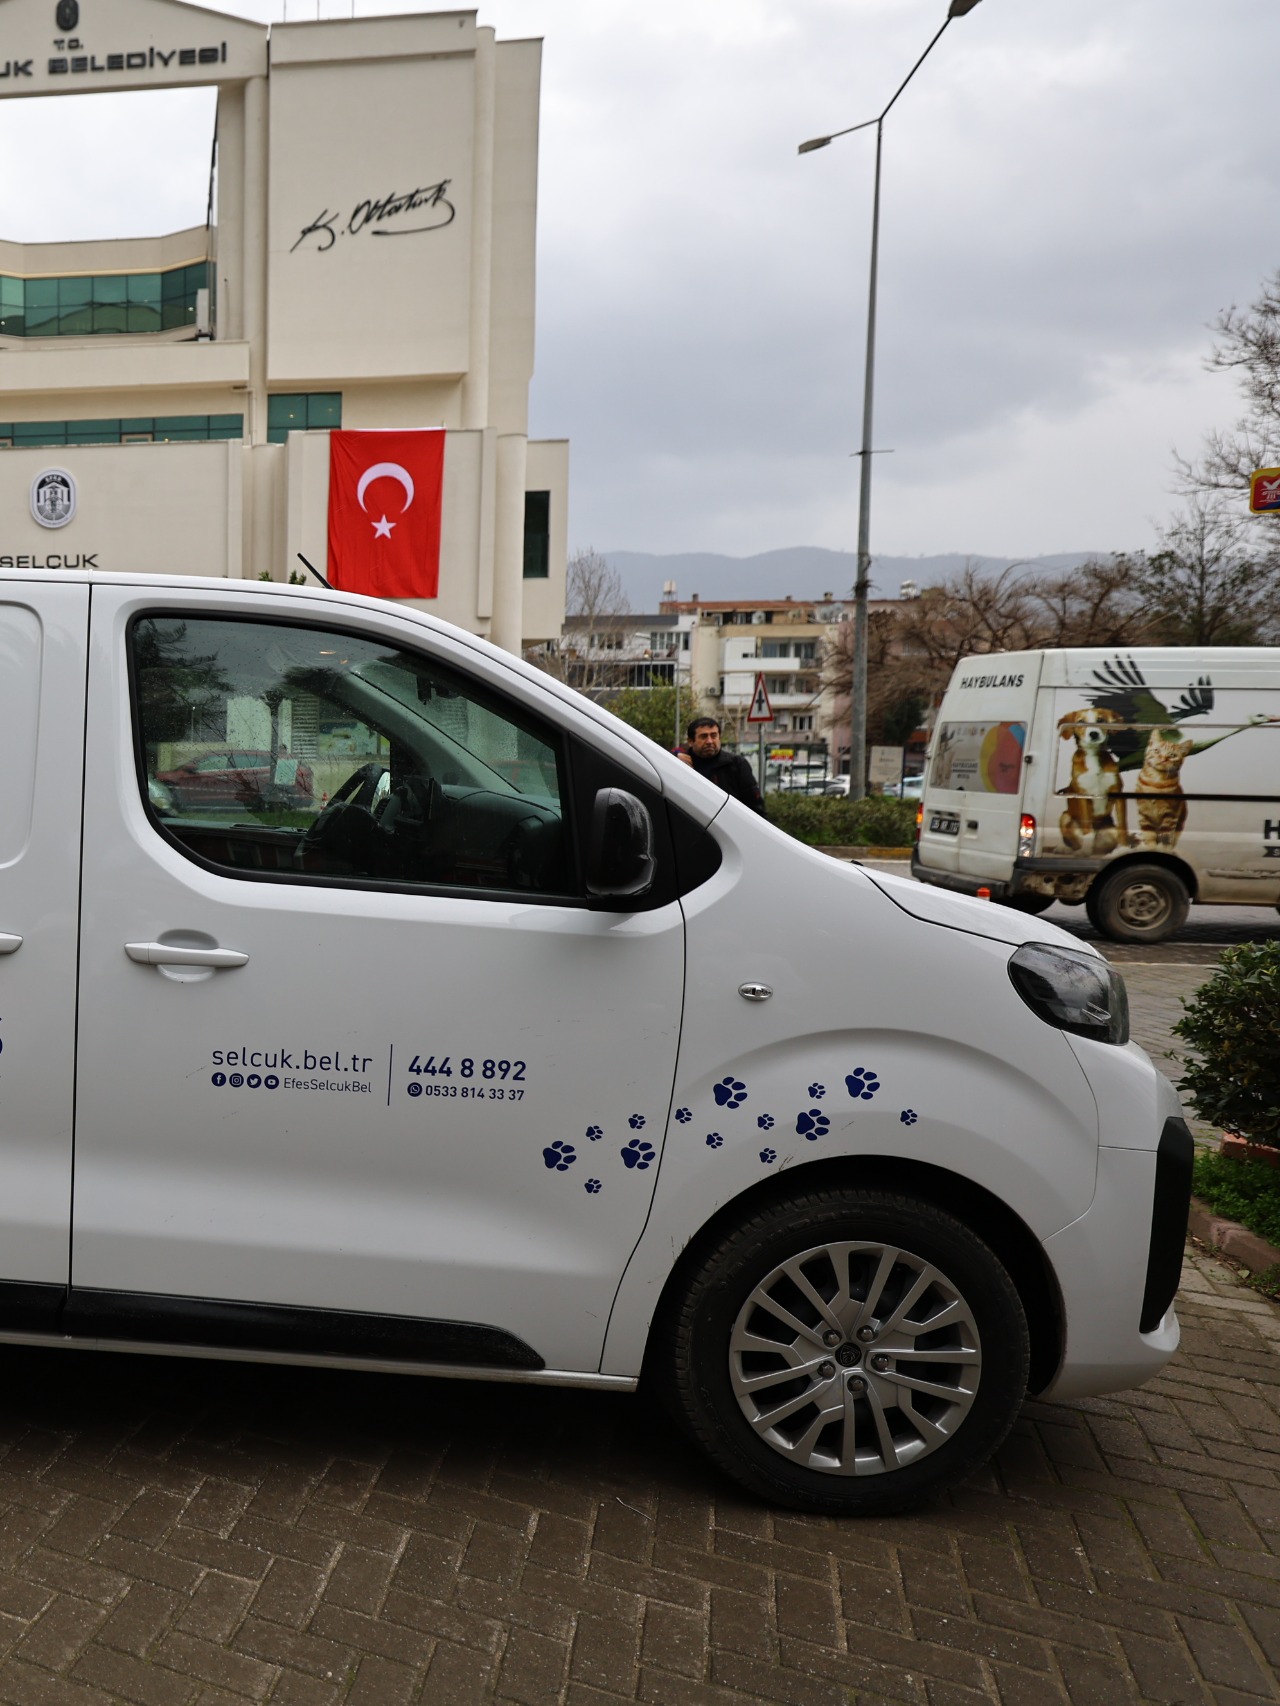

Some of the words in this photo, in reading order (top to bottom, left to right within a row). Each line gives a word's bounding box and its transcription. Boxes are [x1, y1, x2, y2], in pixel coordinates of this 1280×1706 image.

[48, 41, 226, 75] BELEDİYESİ
[960, 674, 1024, 689] HAYBULANS
[212, 1047, 374, 1073] selcuk.bel.tr
[408, 1055, 452, 1077] 444
[460, 1058, 474, 1078] 8
[482, 1059, 526, 1081] 892
[283, 1077, 372, 1093] EfesSelcukBel
[425, 1085, 457, 1097] 0533
[461, 1087, 485, 1099] 814
[489, 1088, 505, 1100] 33
[509, 1089, 525, 1101] 37
